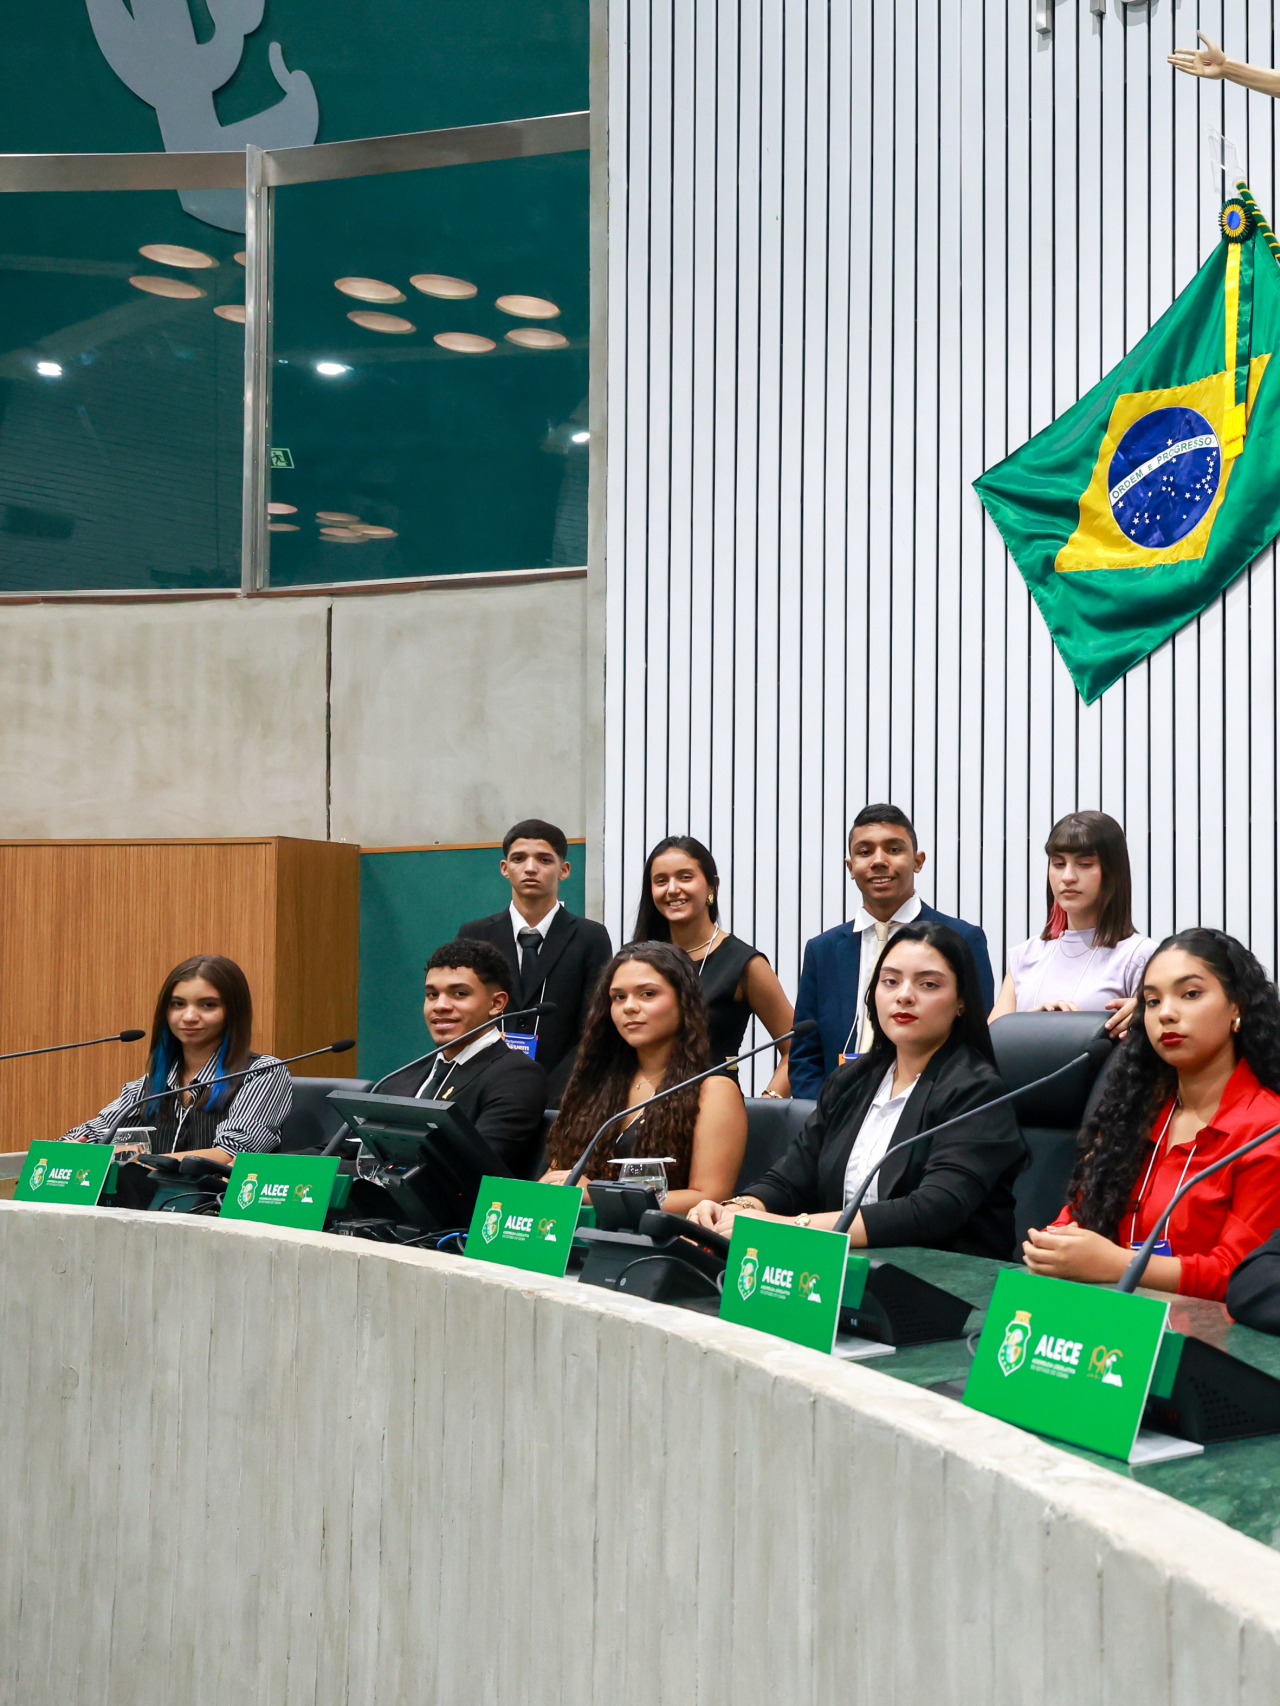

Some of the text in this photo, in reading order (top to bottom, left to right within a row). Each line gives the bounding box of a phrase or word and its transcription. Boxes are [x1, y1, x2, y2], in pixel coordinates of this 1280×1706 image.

[1112, 436, 1212, 499] ORDEM E PROGRESSO
[48, 1168, 73, 1180] ALECE
[260, 1184, 290, 1197] ALECE
[504, 1215, 534, 1232] ALECE
[762, 1265, 794, 1288] ALECE
[1034, 1334, 1083, 1366] ALECE
